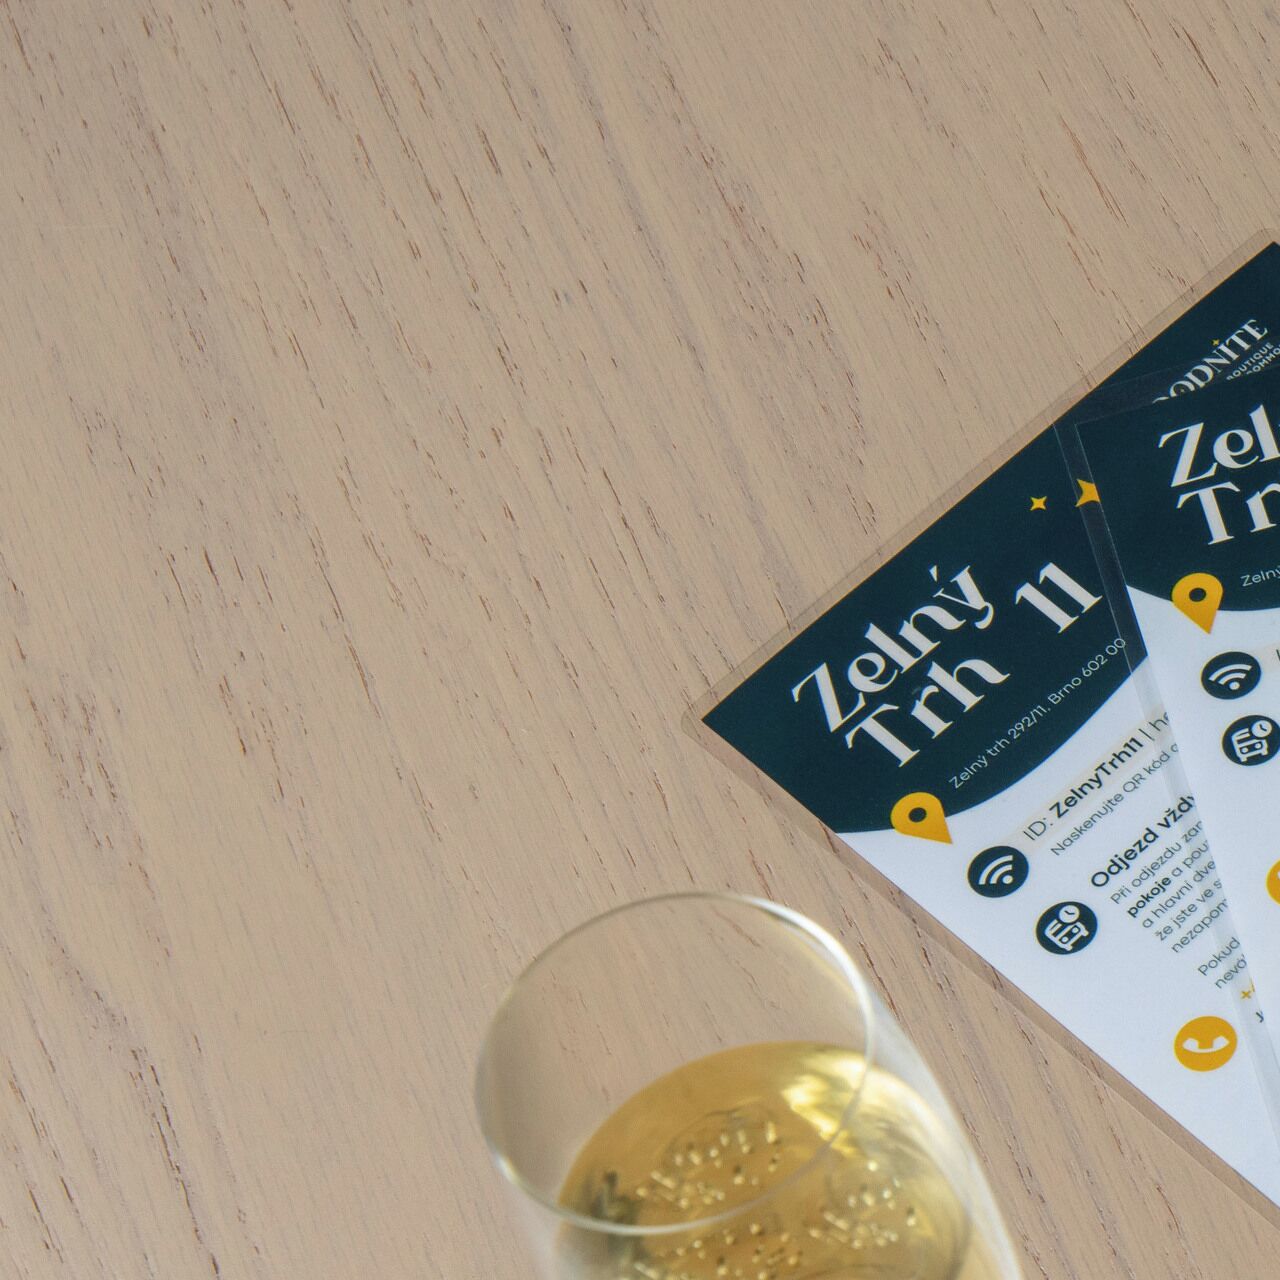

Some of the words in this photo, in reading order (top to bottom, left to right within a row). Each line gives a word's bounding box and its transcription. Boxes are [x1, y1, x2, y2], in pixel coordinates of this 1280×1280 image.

[792, 565, 994, 733] Zelný
[844, 659, 1010, 767] Trh
[1014, 562, 1102, 633] 11
[948, 755, 988, 789] Zelný
[986, 738, 1010, 756] trh
[1047, 677, 1082, 705] Brno
[1081, 654, 1108, 677] 602
[1105, 635, 1128, 655] 00
[1023, 818, 1053, 841] ID:
[1048, 737, 1144, 819] ZelnyTrh11
[1050, 793, 1124, 856] Naskenujte
[1122, 773, 1146, 793] QR
[1142, 750, 1171, 775] kód
[1090, 827, 1159, 887] Odjezd
[1110, 885, 1132, 904] Při
[1131, 842, 1182, 888] odjezdu
[1127, 877, 1172, 918] pokoje
[1171, 867, 1183, 877] a
[1141, 917, 1154, 929] a
[1150, 880, 1193, 918] hlavní
[1154, 925, 1174, 941] že
[1170, 903, 1198, 929] jste
[1196, 888, 1216, 903] ve
[1197, 936, 1241, 976] Pokud
